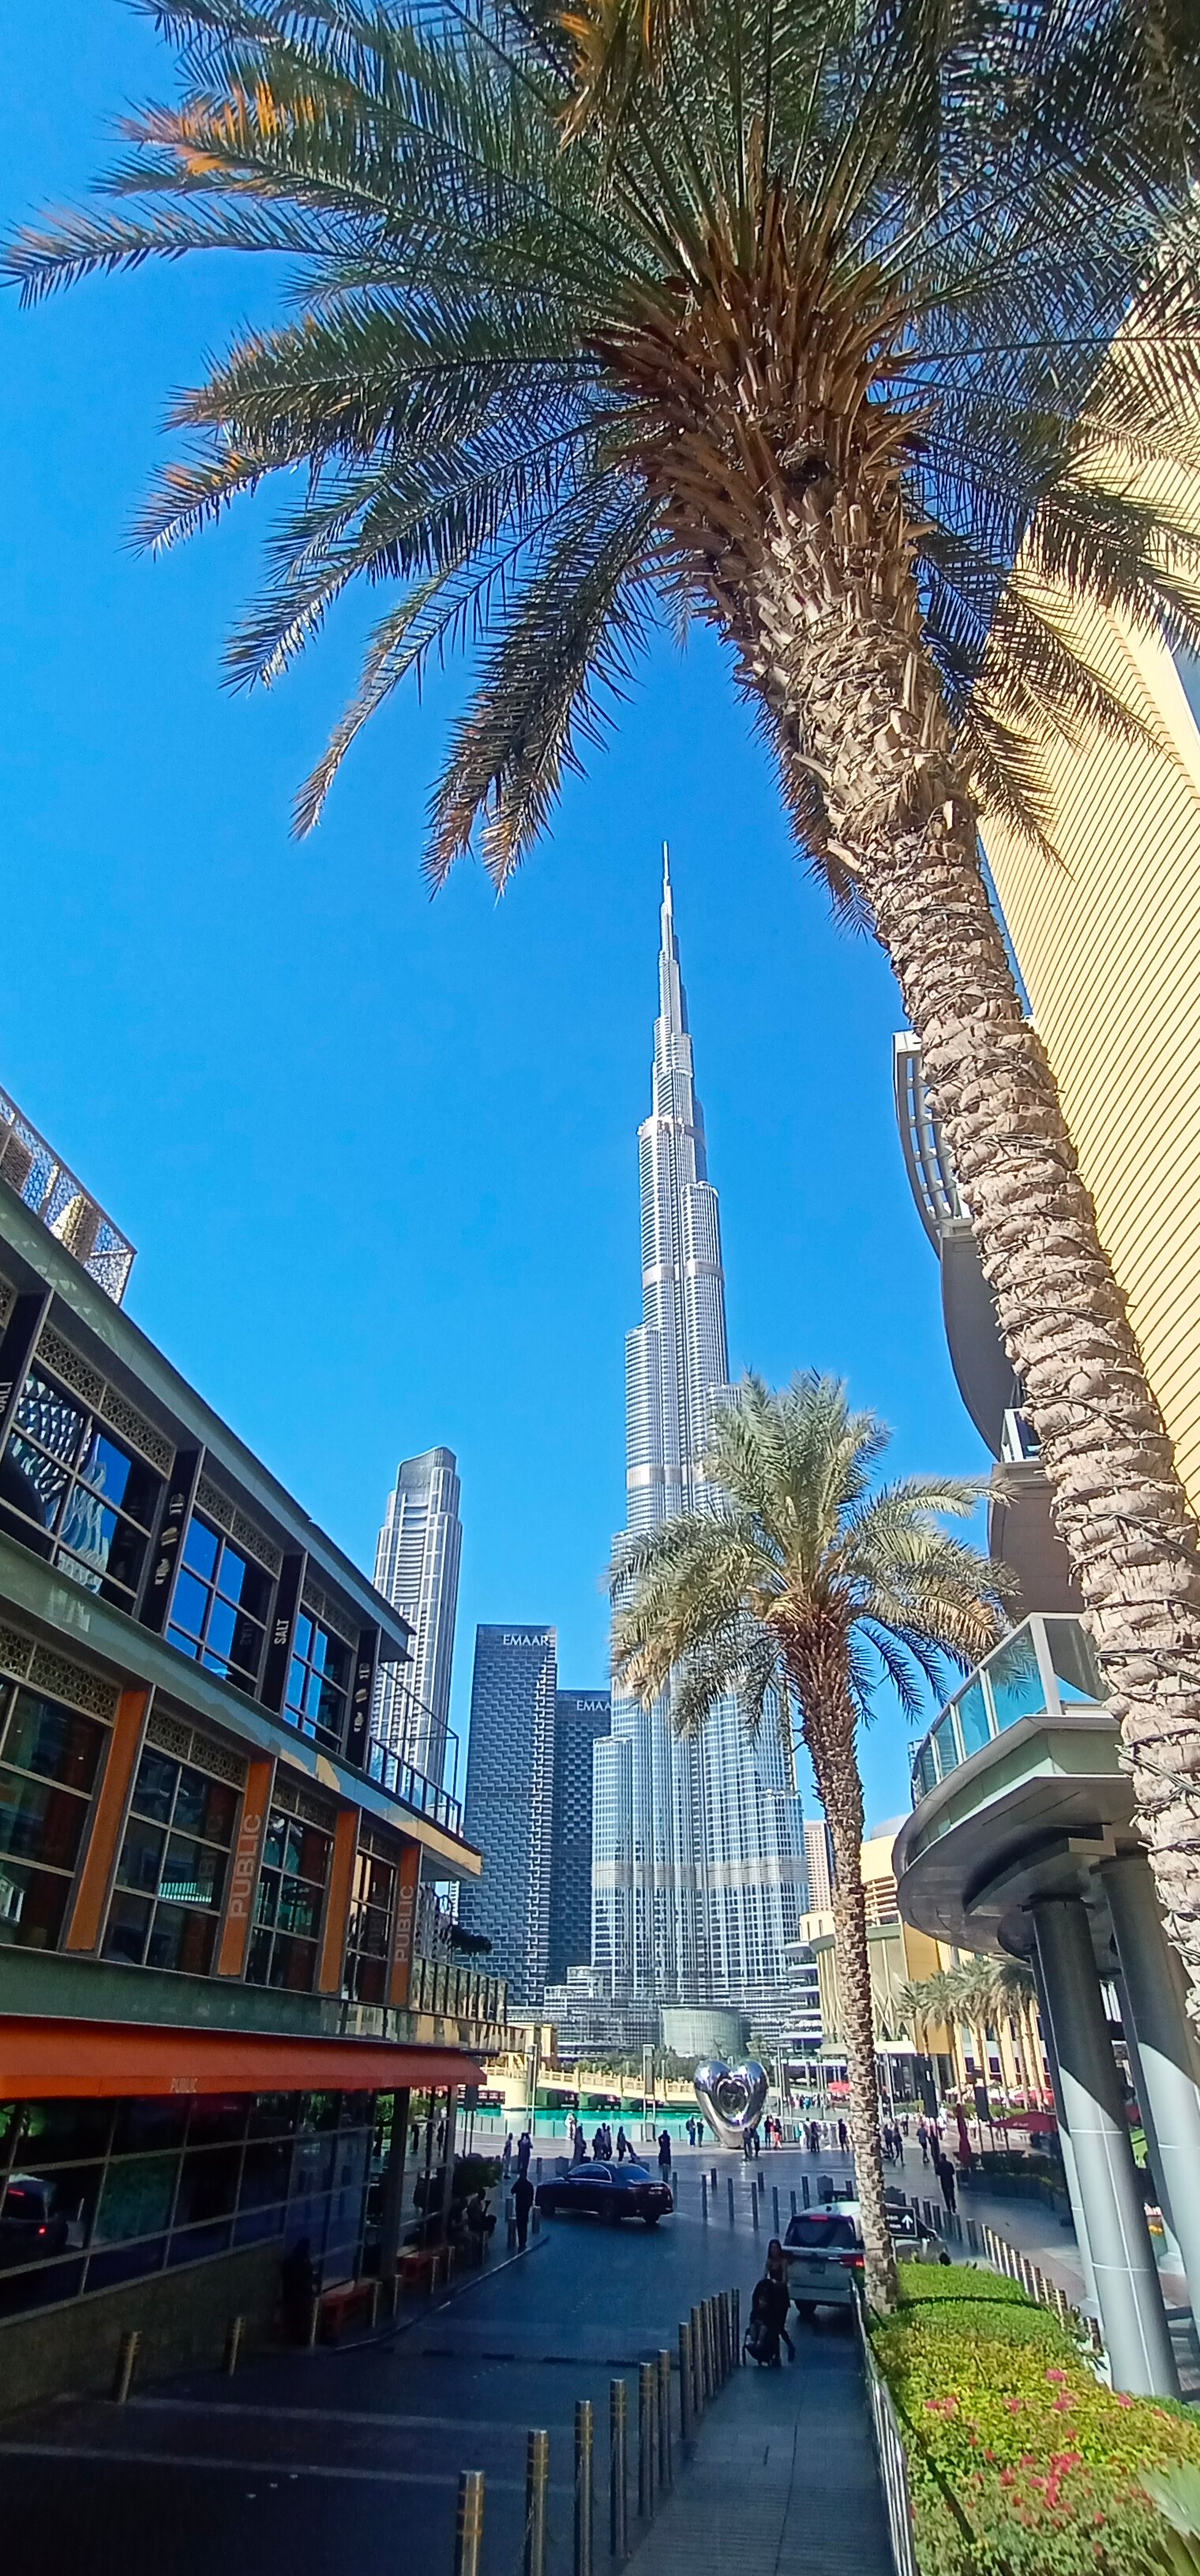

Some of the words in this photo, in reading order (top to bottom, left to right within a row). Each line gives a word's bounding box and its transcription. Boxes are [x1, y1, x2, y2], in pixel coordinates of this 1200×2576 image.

[274, 1619, 290, 1645] SALT
[503, 1634, 549, 1646] EMAAR
[576, 1699, 611, 1711] EMAA
[229, 1814, 261, 1918] PUBLIC
[395, 1885, 414, 1962] PUBLIC
